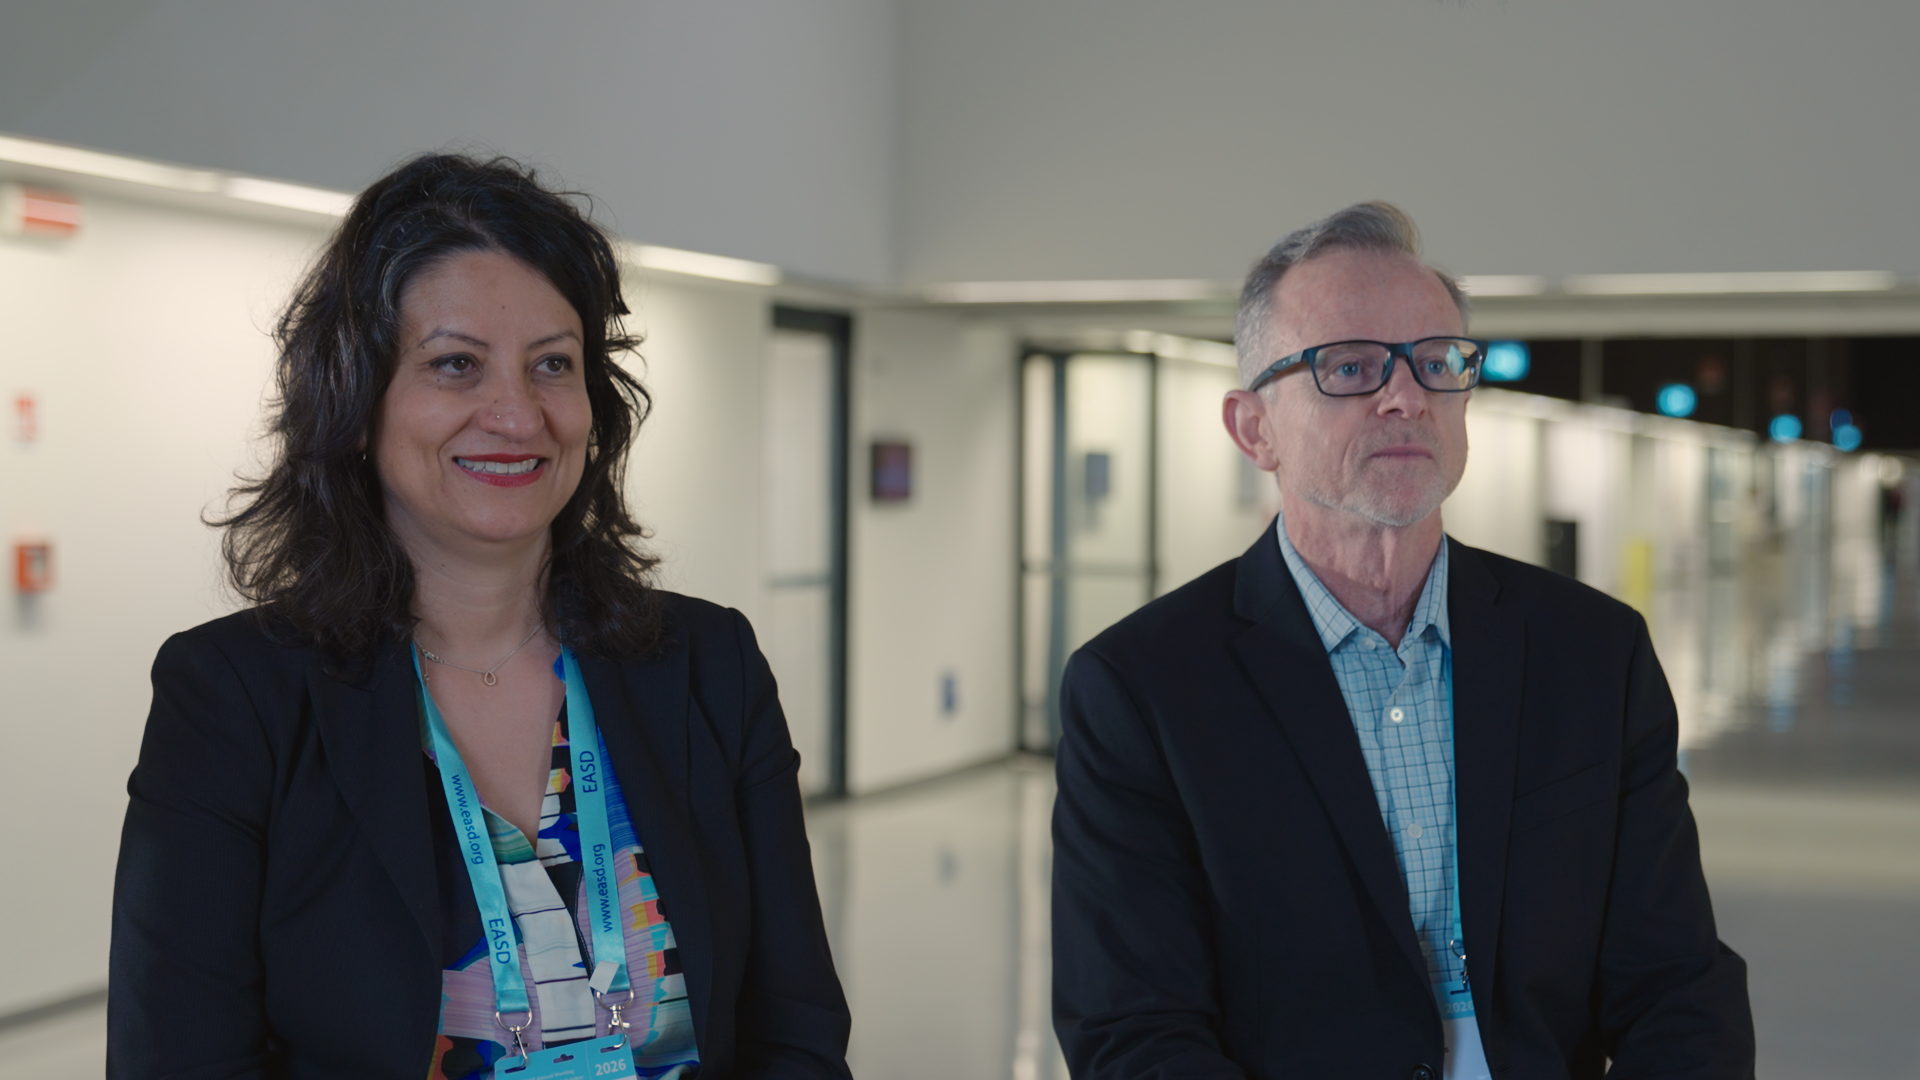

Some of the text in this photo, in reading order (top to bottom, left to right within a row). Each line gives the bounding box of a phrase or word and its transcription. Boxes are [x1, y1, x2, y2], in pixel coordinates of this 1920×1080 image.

[579, 750, 598, 793] EASD
[451, 773, 484, 865] www.easd.org
[592, 843, 613, 933] www.easd.org
[488, 918, 511, 965] EASD
[1446, 1000, 1474, 1014] 2026
[594, 1058, 627, 1077] 2026
